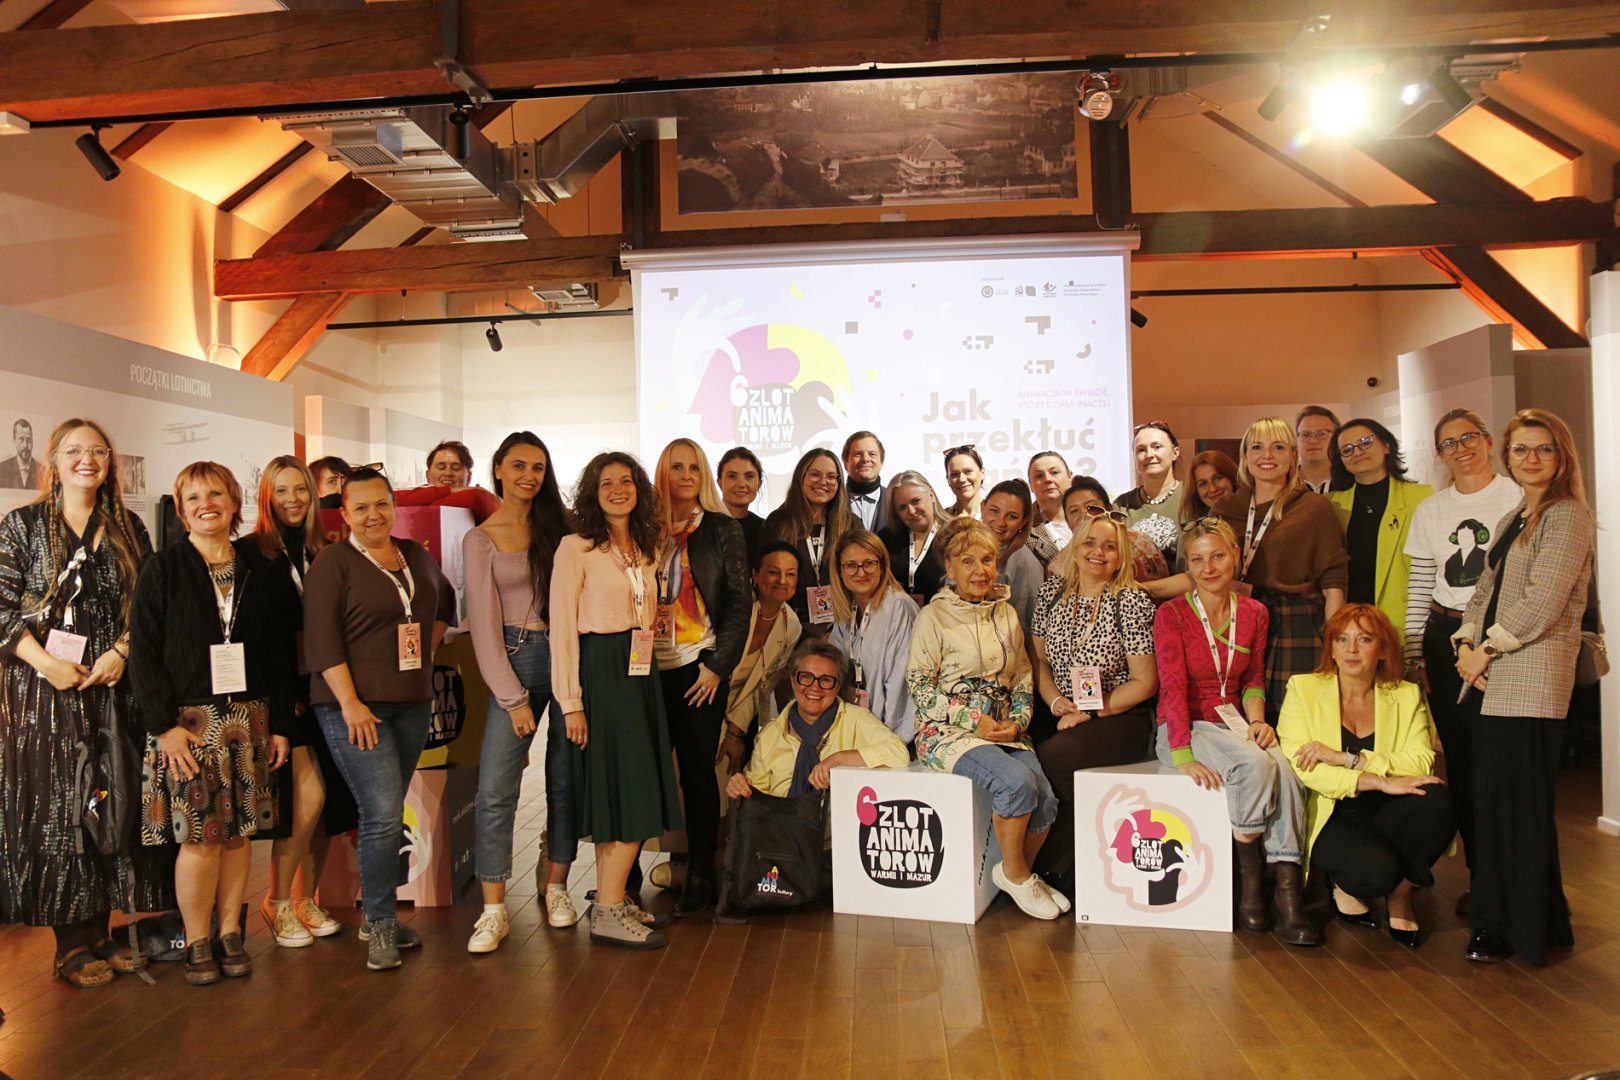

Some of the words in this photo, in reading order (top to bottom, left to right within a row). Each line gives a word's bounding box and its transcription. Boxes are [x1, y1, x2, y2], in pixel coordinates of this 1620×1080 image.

[130, 363, 169, 392] POCZĄTKI
[171, 372, 212, 398] LOTNICTWA
[730, 375, 749, 408] 6
[749, 387, 795, 407] ZLOT
[1017, 389, 1061, 399] ANIMACJA
[1063, 389, 1073, 398] W
[921, 388, 993, 423] Jak
[1018, 400, 1045, 409] KTÓRY
[1046, 400, 1075, 409] DZIAŁA
[1077, 399, 1111, 408] INACZEJ
[738, 405, 795, 427] ANIMA
[738, 424, 795, 444] TORÓW
[922, 416, 1096, 465] przekłuć
[856, 785, 878, 826] 6
[878, 805, 934, 829] ZLOT
[866, 827, 935, 852] ANIMA
[1140, 840, 1164, 849] ZLOT
[866, 849, 935, 873] TORÓW
[1135, 847, 1163, 859] ANIMA
[870, 869, 897, 880] WARMII
[906, 872, 933, 882] MAZUR
[757, 883, 777, 893] TOR
[170, 940, 186, 949] TO
